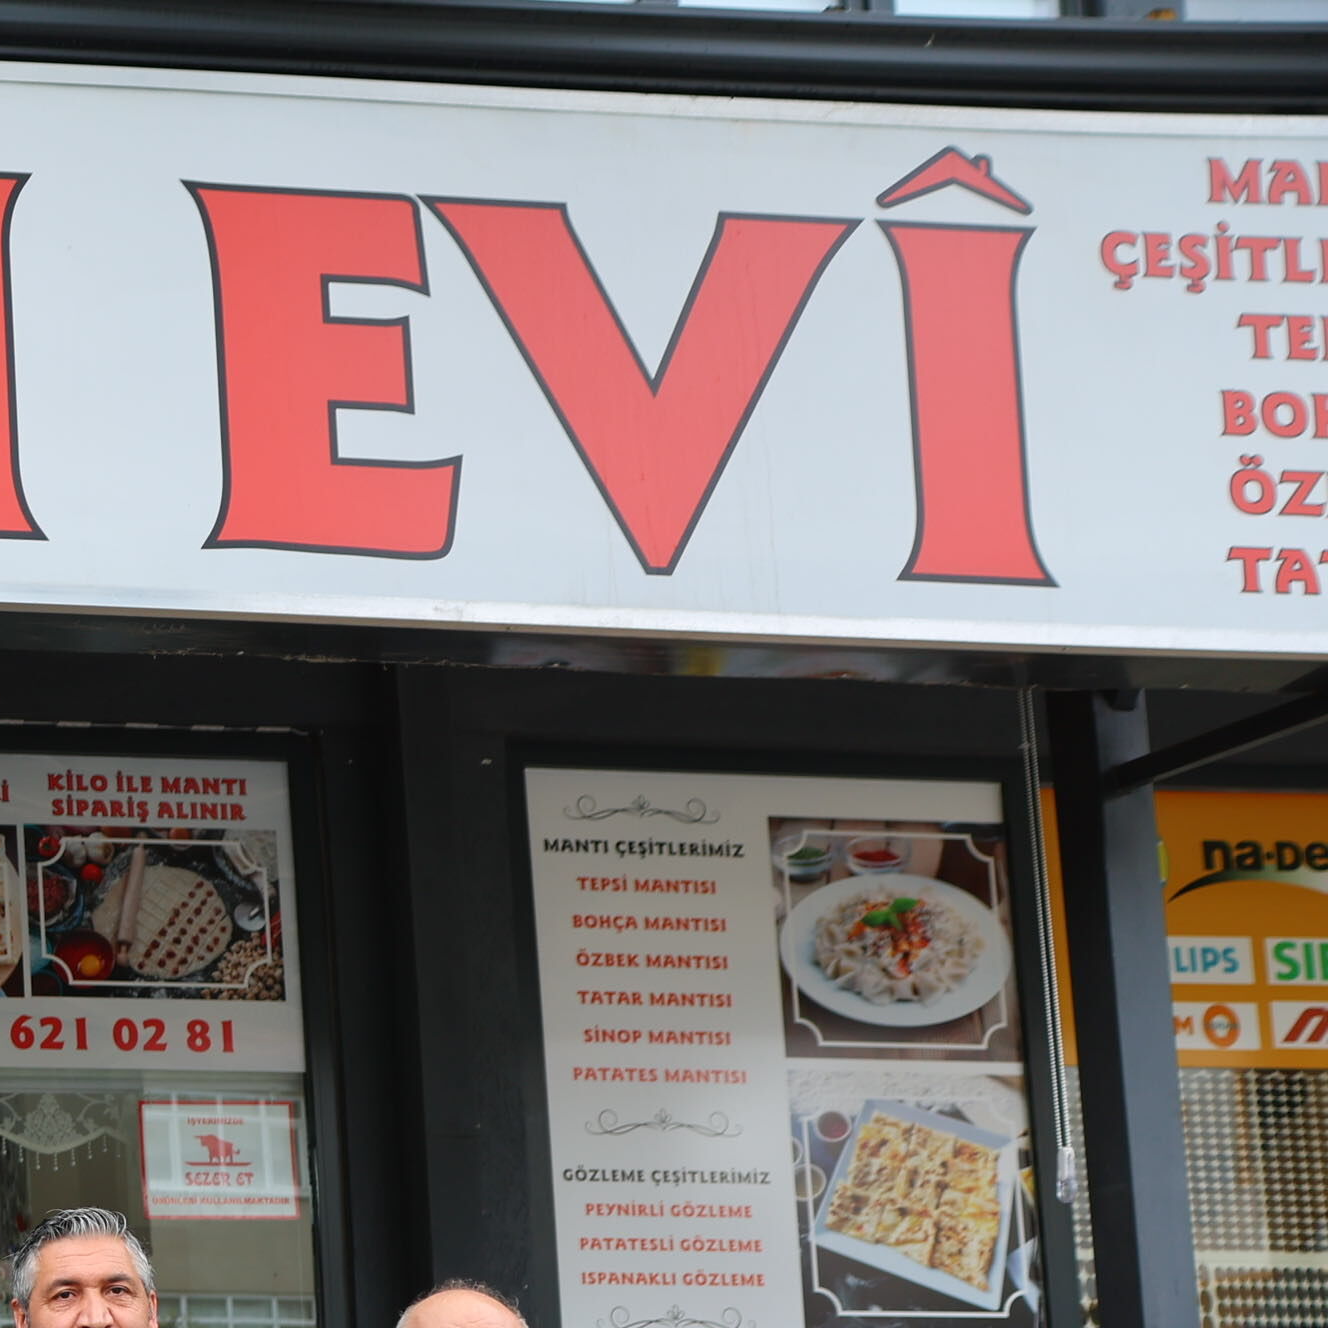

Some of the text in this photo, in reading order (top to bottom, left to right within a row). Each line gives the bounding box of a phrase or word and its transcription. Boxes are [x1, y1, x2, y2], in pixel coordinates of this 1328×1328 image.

[1100, 221, 1328, 293] ÇEŞİTL
[1237, 313, 1328, 362] TE
[1229, 455, 1328, 518] ÖZ
[47, 770, 248, 796] KİLO İLE MANTI
[52, 795, 248, 822] SİPARİŞ ALINIR
[544, 836, 745, 859] MANTI ÇEŞİTLERİMİZ
[577, 874, 716, 895] TEPSİ MANTISI
[572, 914, 726, 935] BOHÇA MANTISI
[576, 948, 728, 970] ÖZBEK MANTISI
[578, 991, 732, 1008] TATAR MANTISI
[11, 1015, 88, 1050] 621
[113, 1018, 168, 1051] 02
[186, 1019, 234, 1053] 81
[584, 1026, 731, 1046] SİNOP MANTISI
[573, 1067, 747, 1085] PATATES MANTISI
[563, 1166, 771, 1187] GÖZLEME ÇEŞİTLERİMİZ
[585, 1201, 752, 1219] PEYNİRLİ GÖZLEME
[579, 1235, 762, 1253] PATATESLİ GÖZLEME
[581, 1270, 765, 1287] ISPANAKLI GÖZLEME
